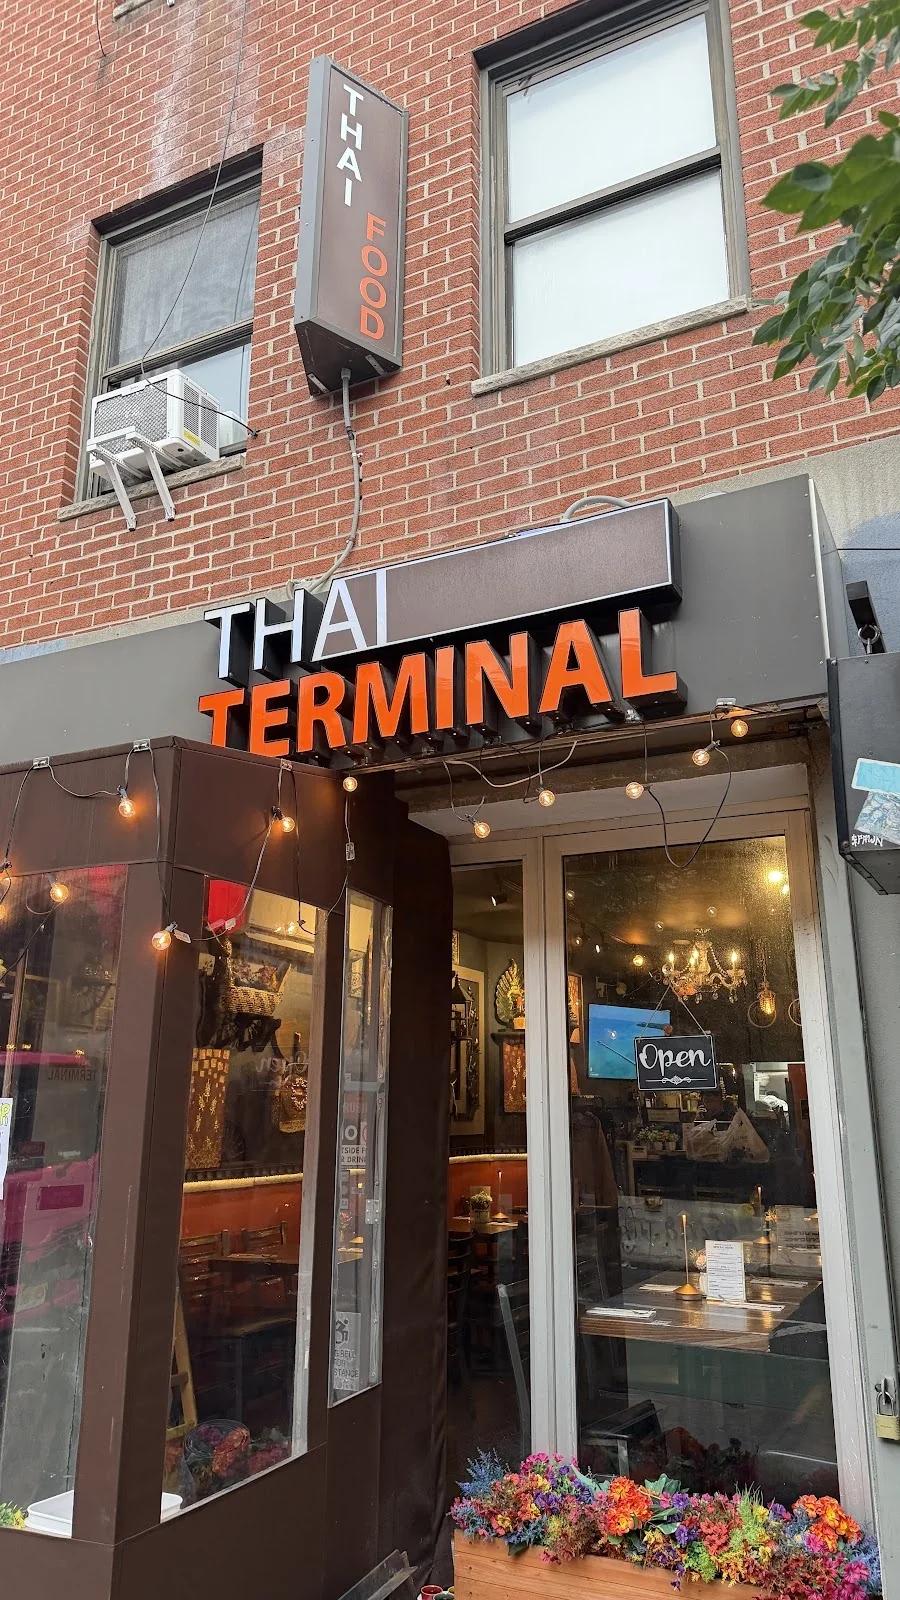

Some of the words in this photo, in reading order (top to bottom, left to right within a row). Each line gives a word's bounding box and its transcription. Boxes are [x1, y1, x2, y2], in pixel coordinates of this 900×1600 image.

[336, 83, 364, 207] THAI
[358, 212, 388, 341] FOOD
[198, 607, 678, 758] TERMINAL
[203, 567, 389, 680] THAI
[639, 1043, 711, 1076] Open
